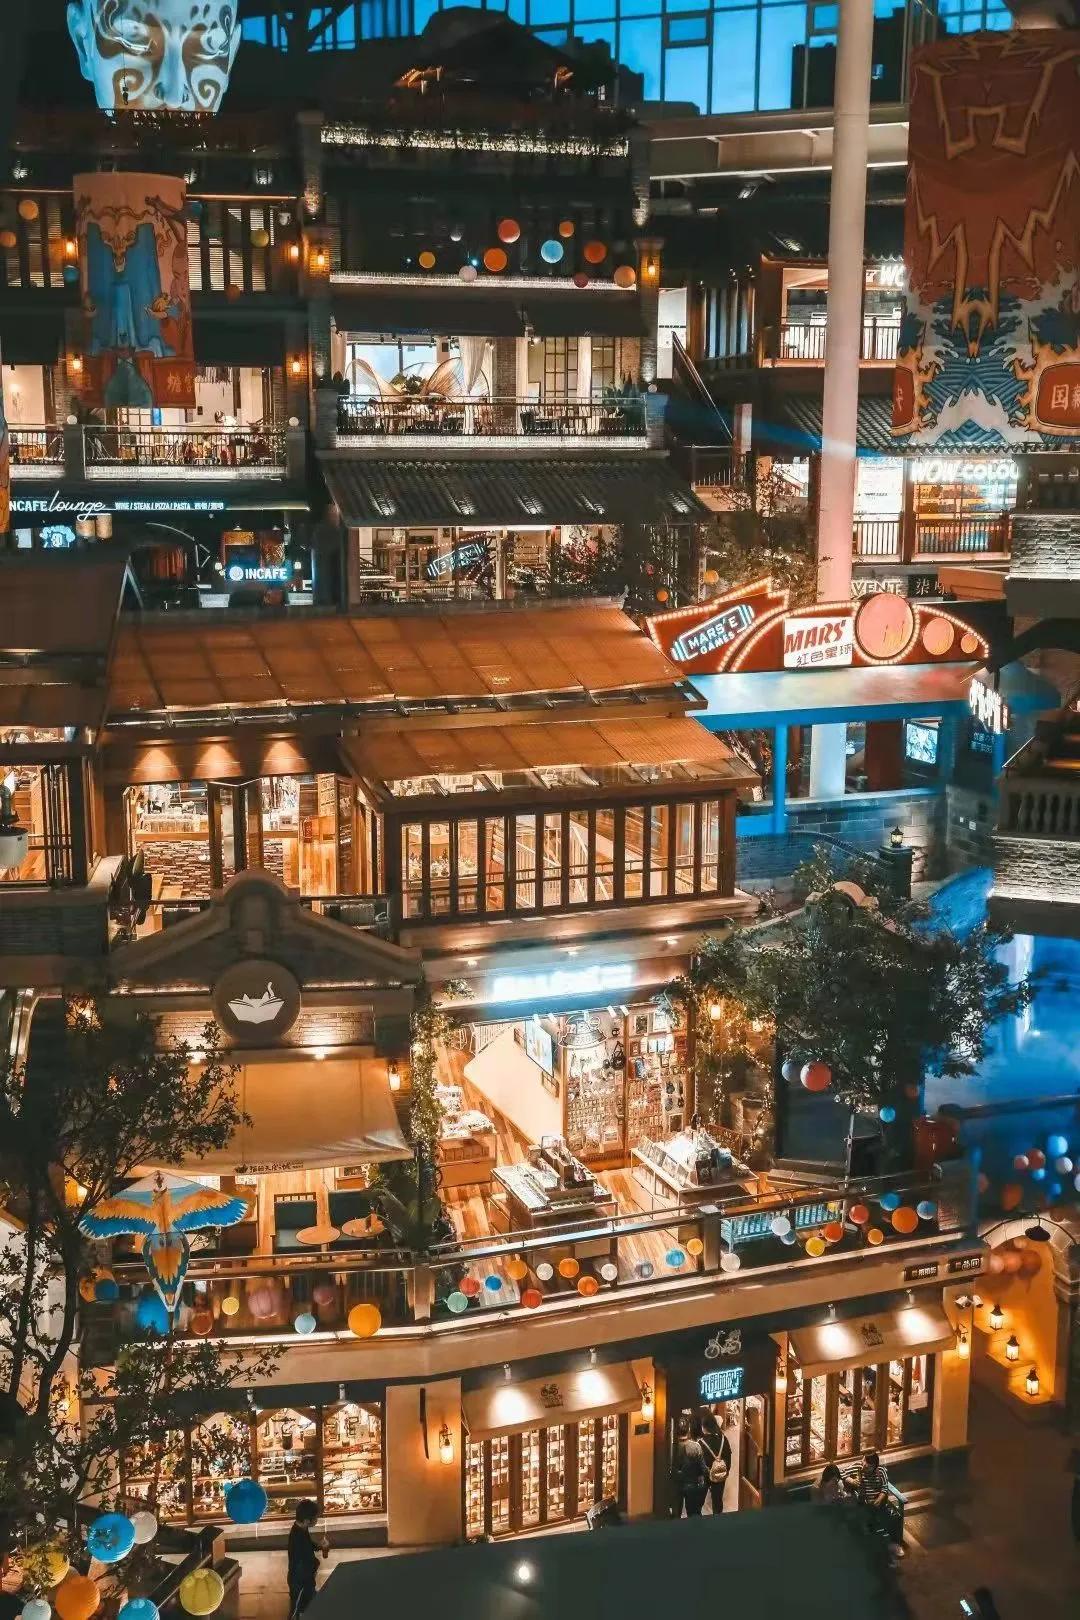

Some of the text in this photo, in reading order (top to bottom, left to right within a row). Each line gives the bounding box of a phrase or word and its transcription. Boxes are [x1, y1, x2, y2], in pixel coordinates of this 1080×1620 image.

[48, 490, 111, 522] lounge
[174, 502, 191, 511] PASTA
[245, 568, 288, 580] INCAFE
